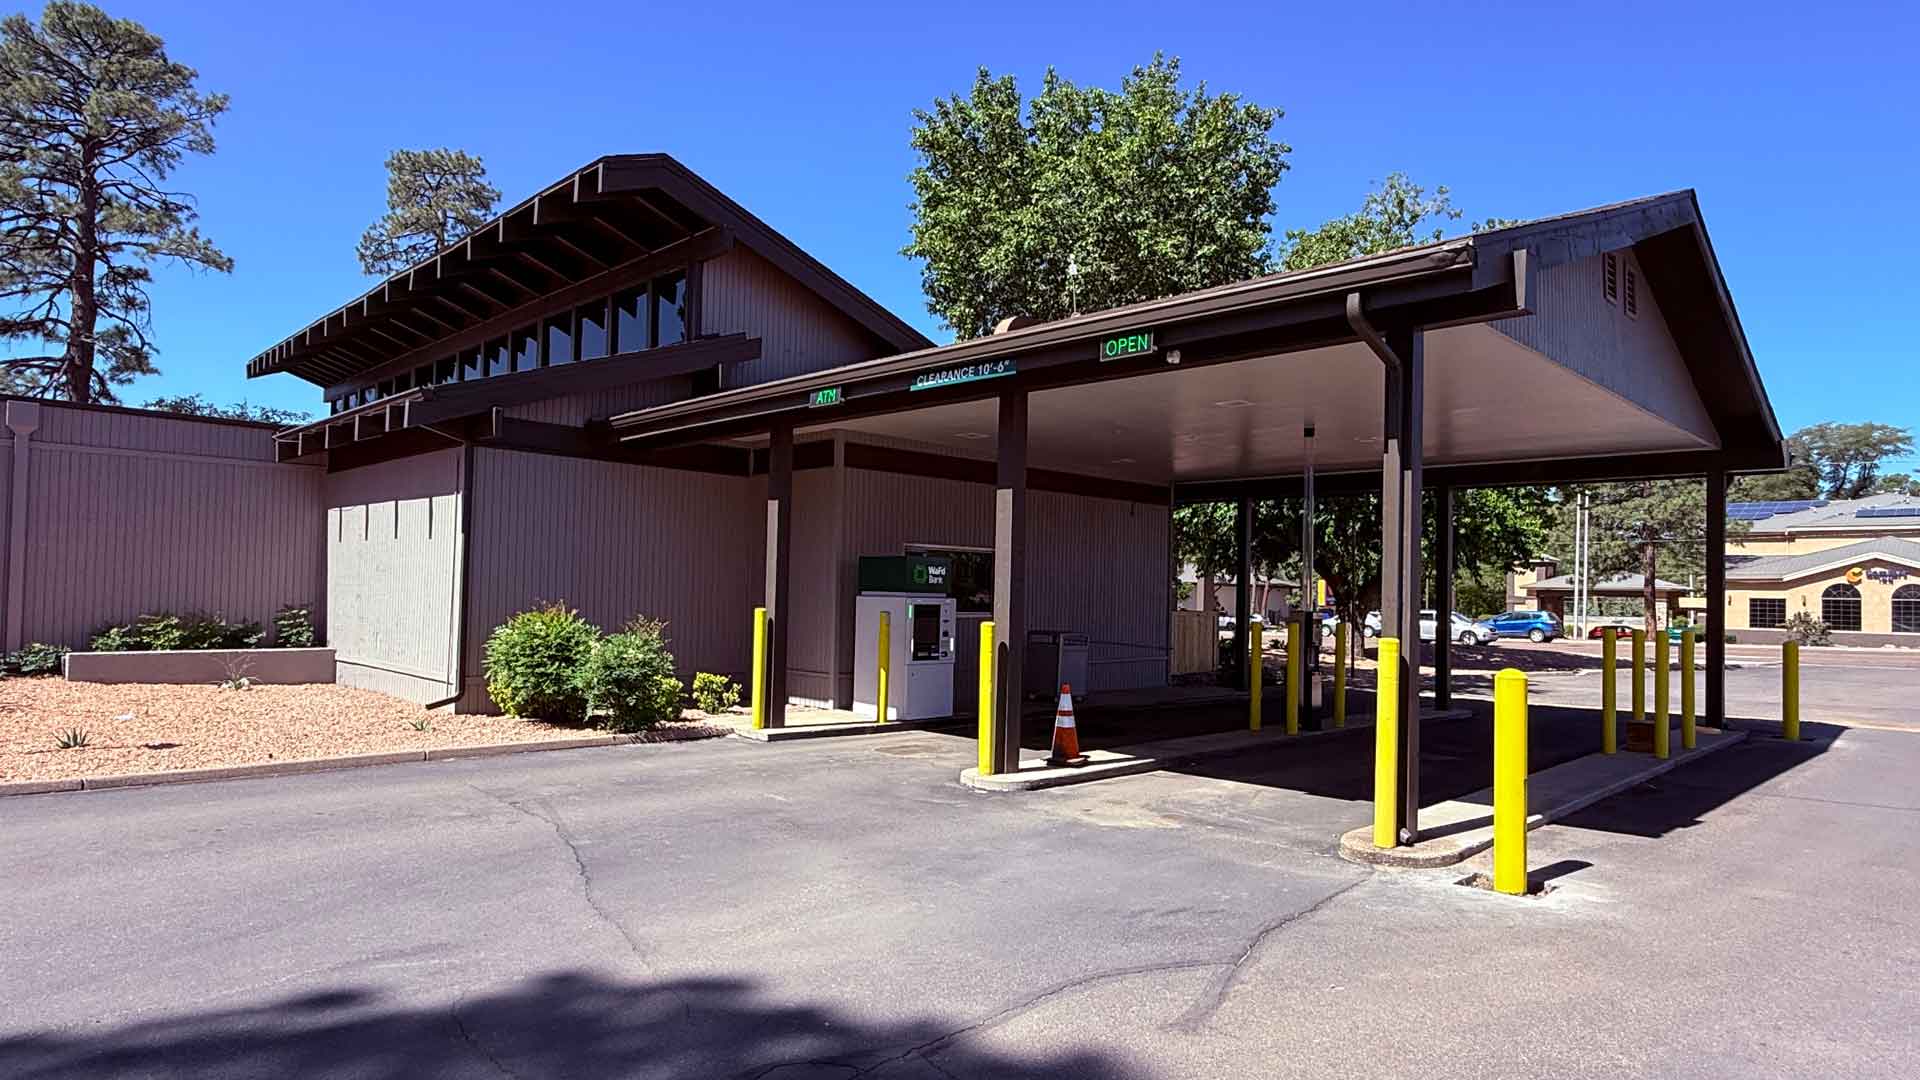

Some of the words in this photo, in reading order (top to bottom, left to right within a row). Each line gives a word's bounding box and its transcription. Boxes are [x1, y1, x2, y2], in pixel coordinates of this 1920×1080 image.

[1106, 333, 1148, 356] OPEN
[916, 366, 976, 386] CLEARANCE
[816, 388, 836, 405] ATM
